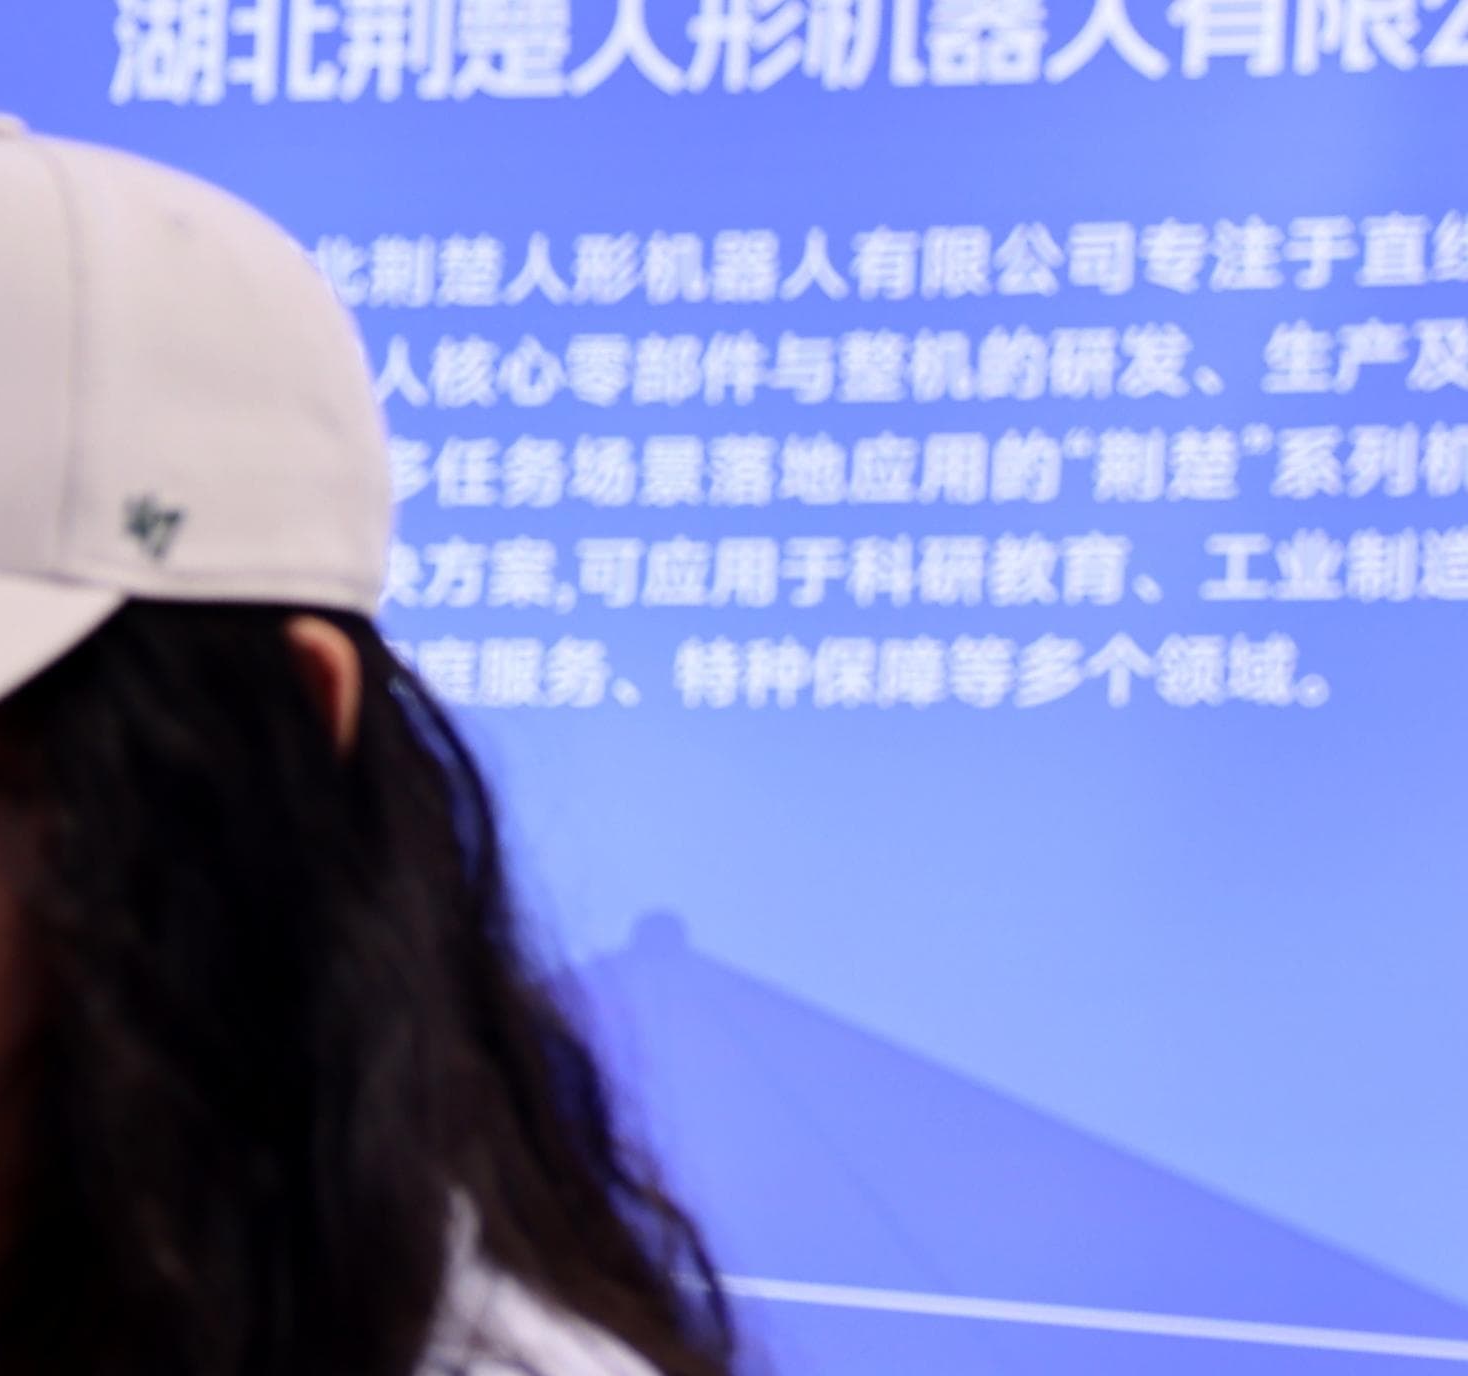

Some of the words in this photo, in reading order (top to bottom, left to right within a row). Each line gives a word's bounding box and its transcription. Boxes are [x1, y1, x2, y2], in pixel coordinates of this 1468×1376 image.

[393, 633, 1329, 708] 庭服务、特种保障等多个领域。
